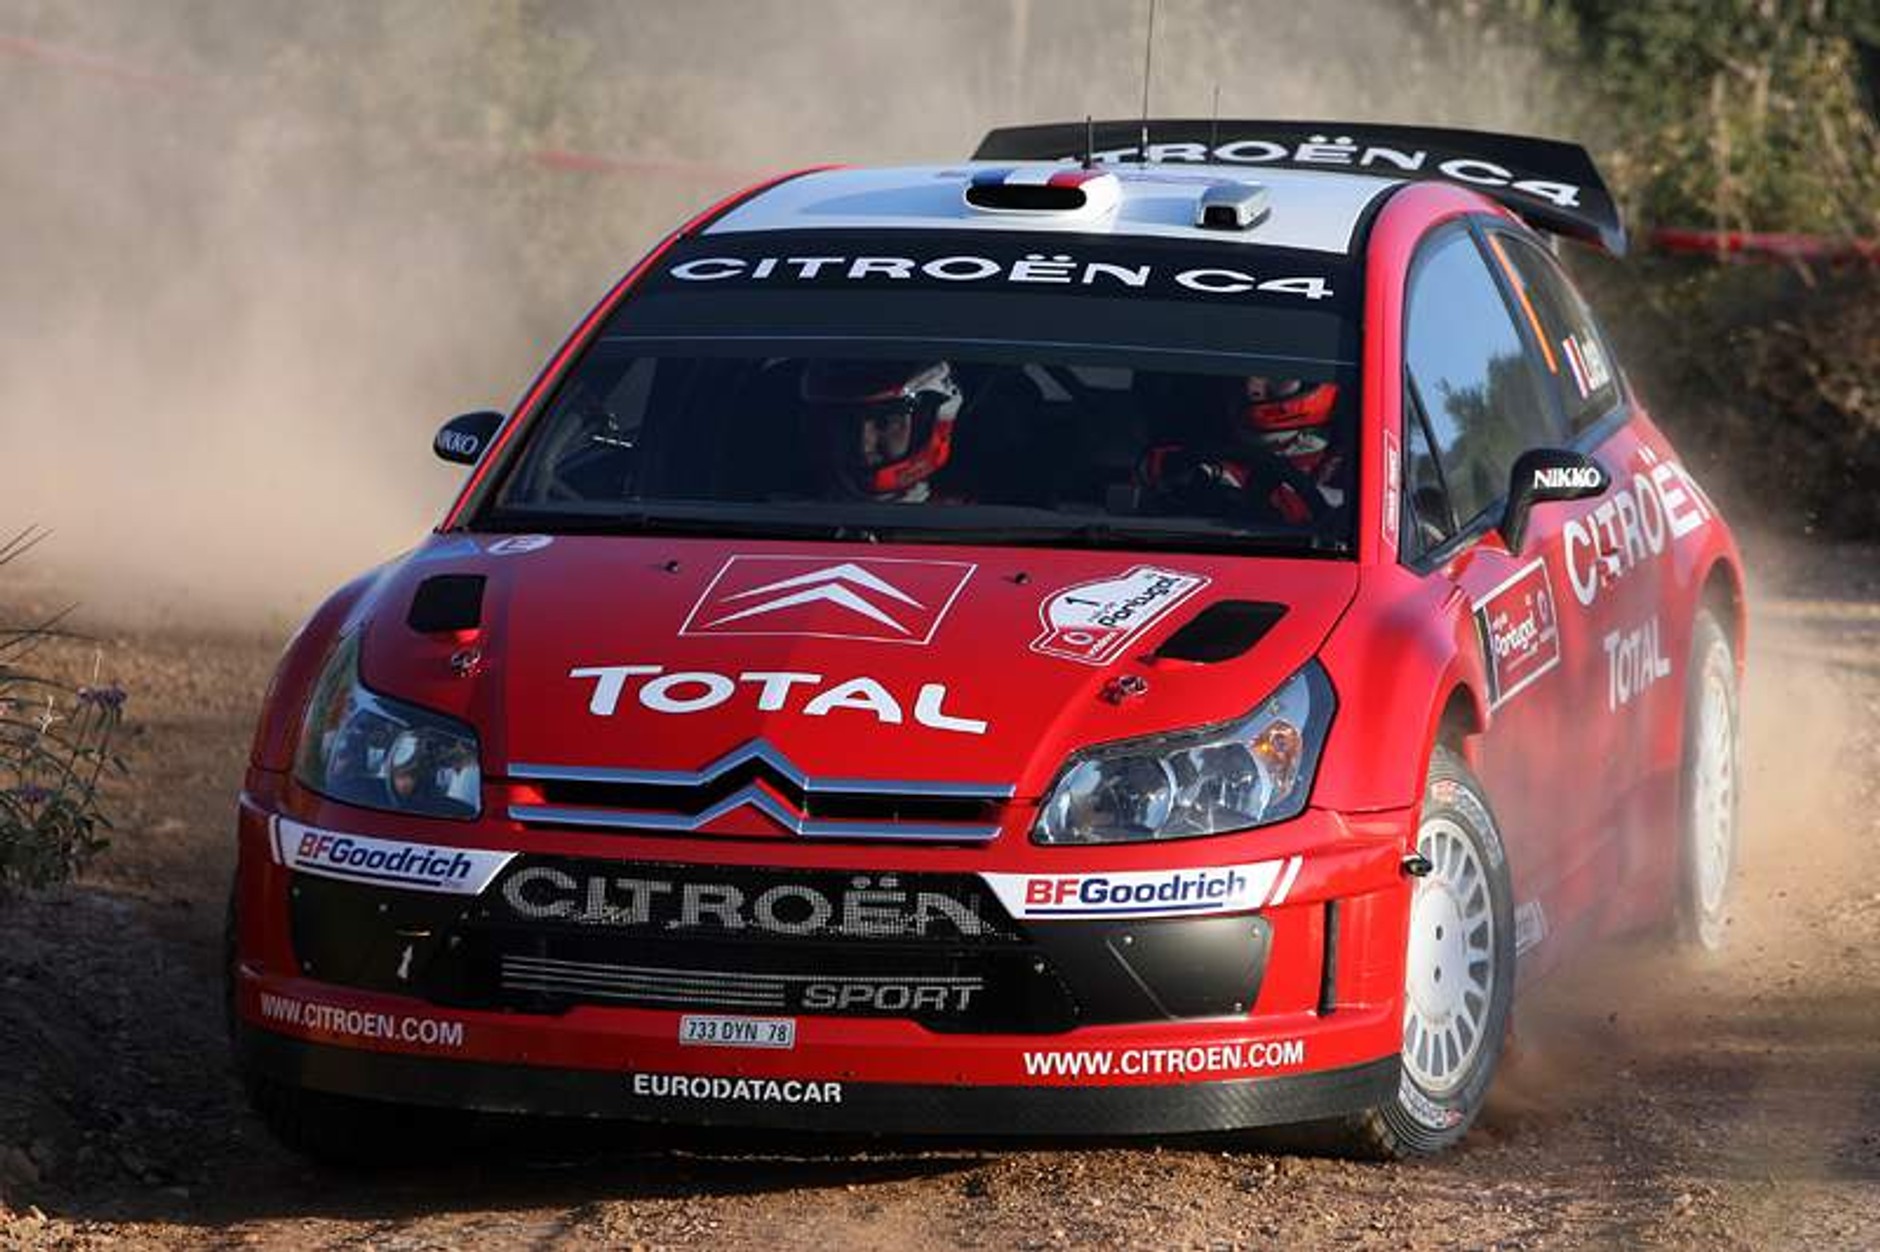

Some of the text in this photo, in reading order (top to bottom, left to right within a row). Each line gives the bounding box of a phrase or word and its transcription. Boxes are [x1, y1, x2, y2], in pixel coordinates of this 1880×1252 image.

[1438, 158, 1581, 210] C4
[669, 253, 1335, 301] CITROËN C4
[1532, 467, 1601, 489] NIKKO
[298, 831, 473, 879] BFGoodrich
[501, 866, 983, 936] CITROËN
[1024, 868, 1247, 906] BFGoodrich
[801, 982, 984, 1012] SPORT
[259, 992, 464, 1047] WWW.CITROEN.COM
[688, 1020, 788, 1042] 733 DYN 78
[1023, 1039, 1304, 1077] WWW.CITROEN.COM
[633, 1073, 843, 1104] EURODATACAR
